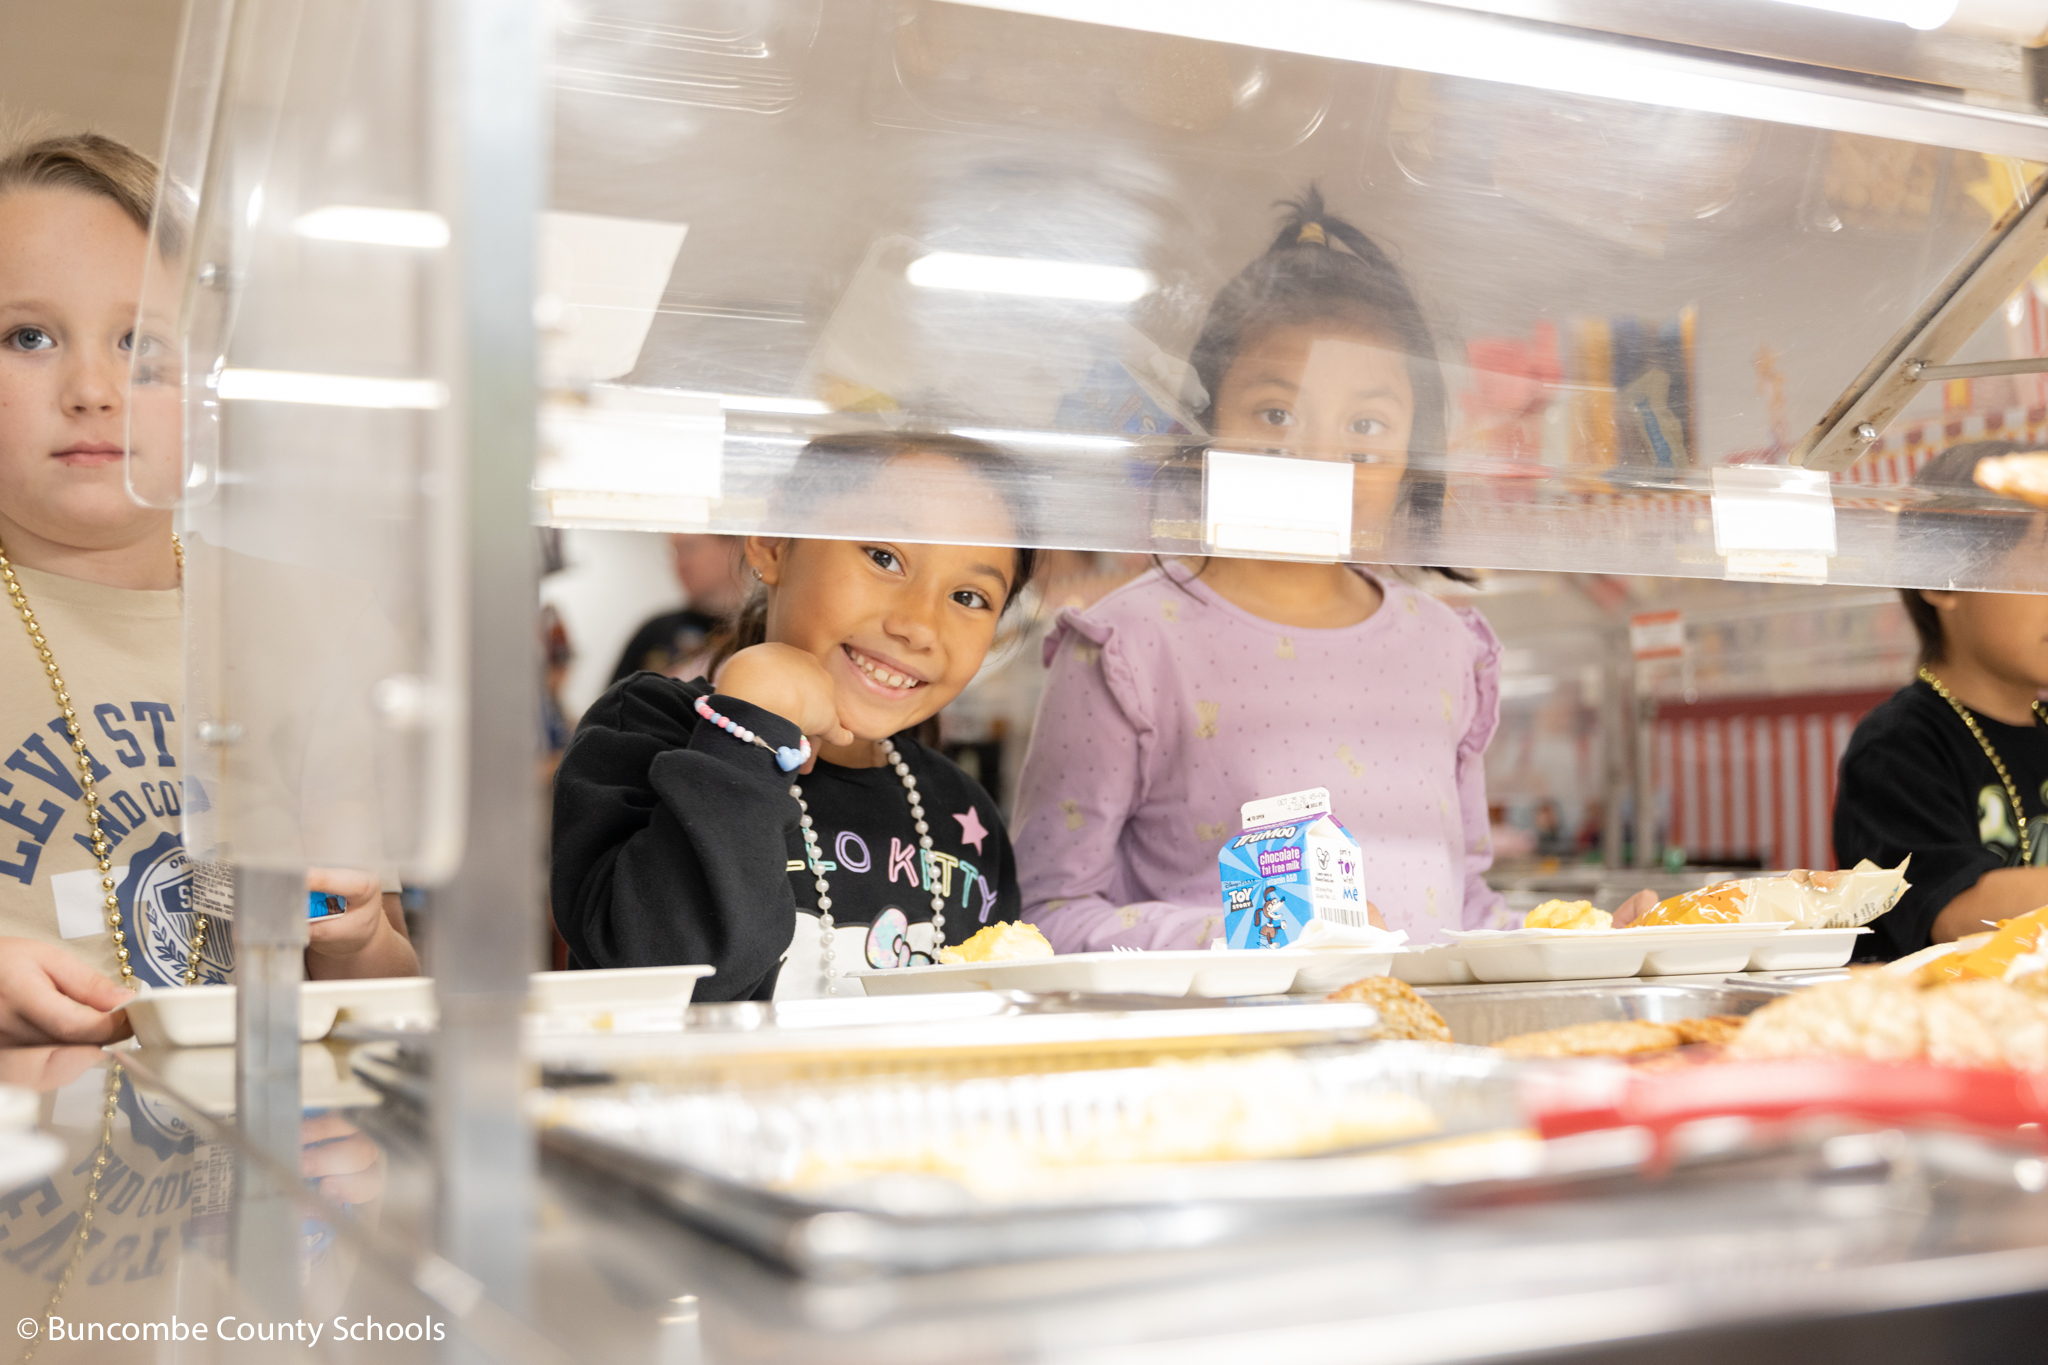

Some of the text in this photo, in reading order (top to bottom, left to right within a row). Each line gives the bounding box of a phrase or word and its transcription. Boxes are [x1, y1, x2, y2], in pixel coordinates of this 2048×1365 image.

[72, 789, 147, 861] AND
[1259, 848, 1301, 865] chocolate
[787, 828, 998, 923] LO KITTY
[1262, 860, 1301, 876] fat free milk
[1266, 876, 1286, 886] vitamin
[1231, 900, 1252, 911] STORY
